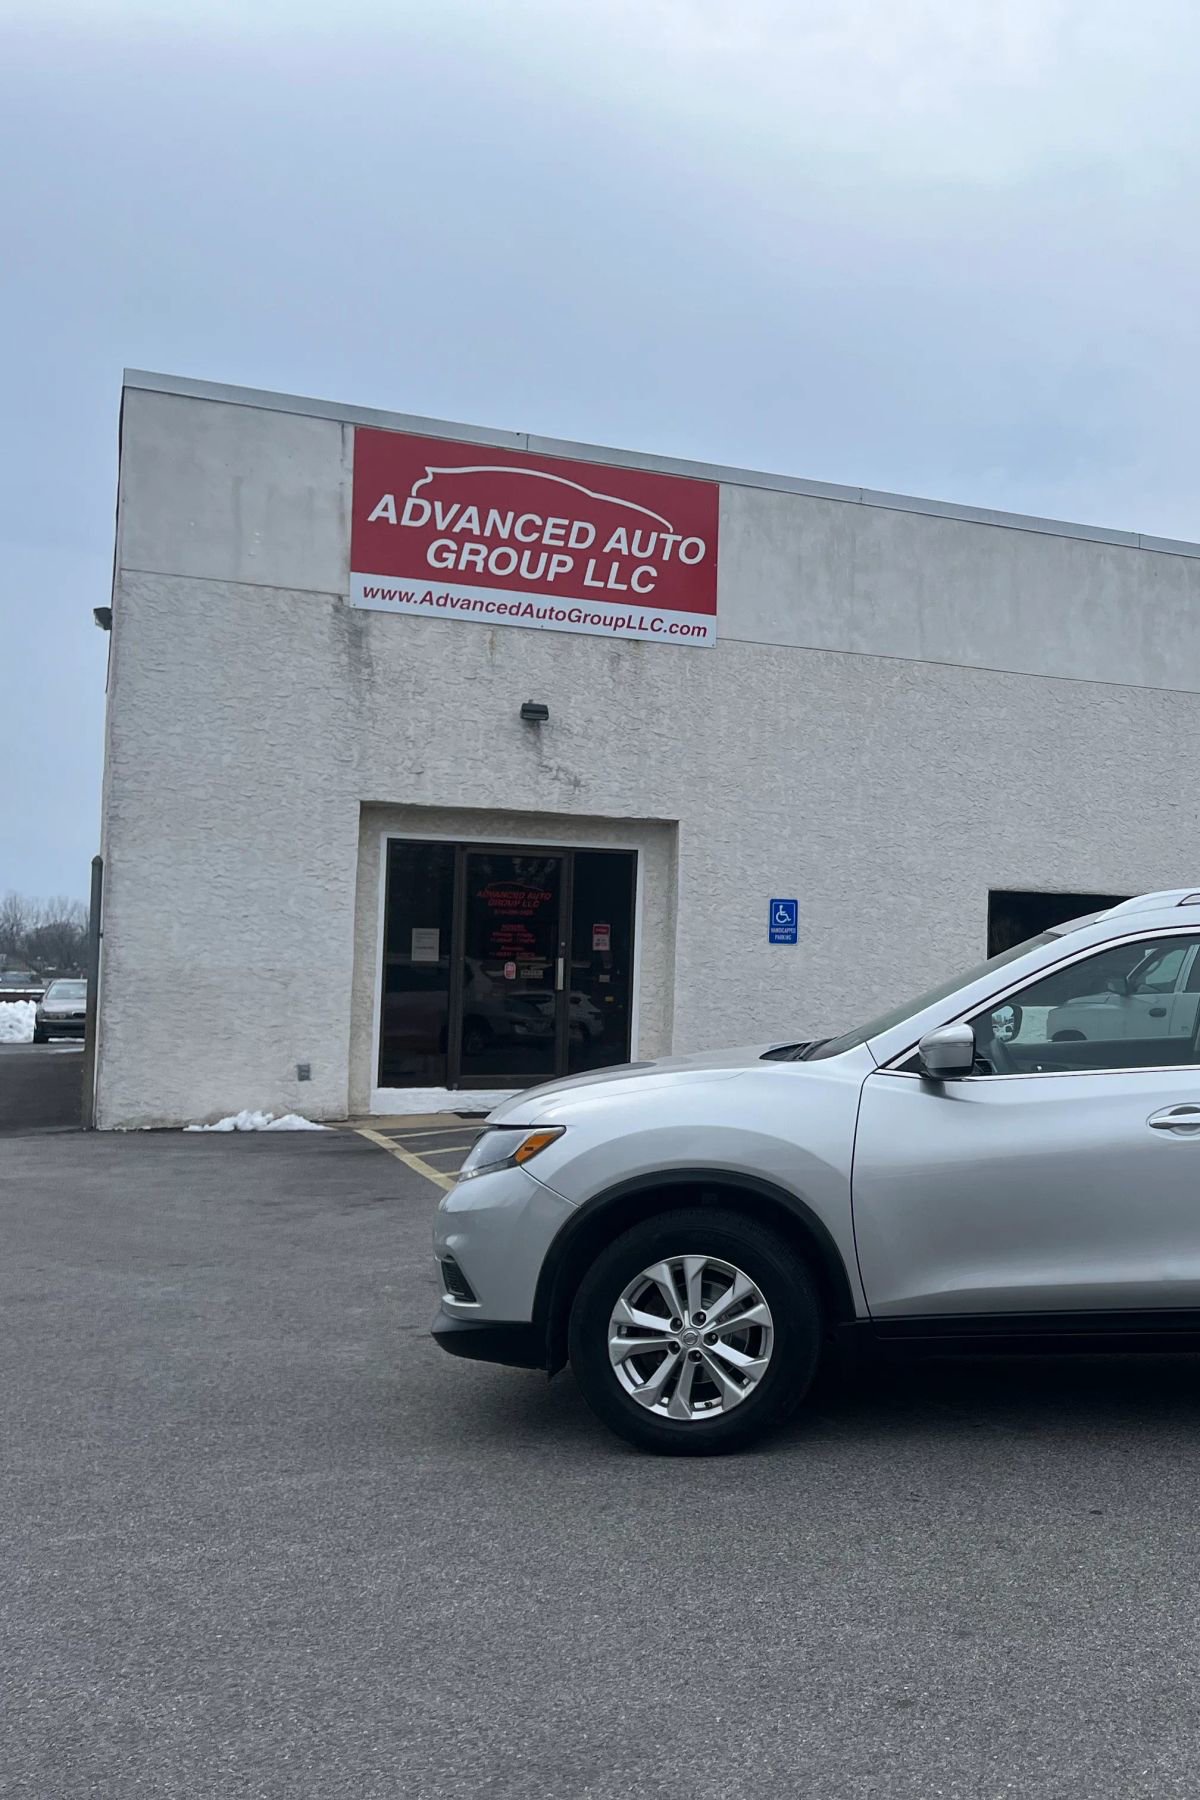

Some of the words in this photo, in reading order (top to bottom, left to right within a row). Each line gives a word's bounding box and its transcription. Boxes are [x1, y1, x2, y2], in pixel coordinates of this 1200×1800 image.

[367, 493, 596, 550] ADVANCED
[602, 526, 706, 565] AUTO
[426, 538, 574, 582] GROUP
[583, 559, 659, 594] LLC
[362, 584, 708, 638] www.AdvancedAutoGroupLLC.com
